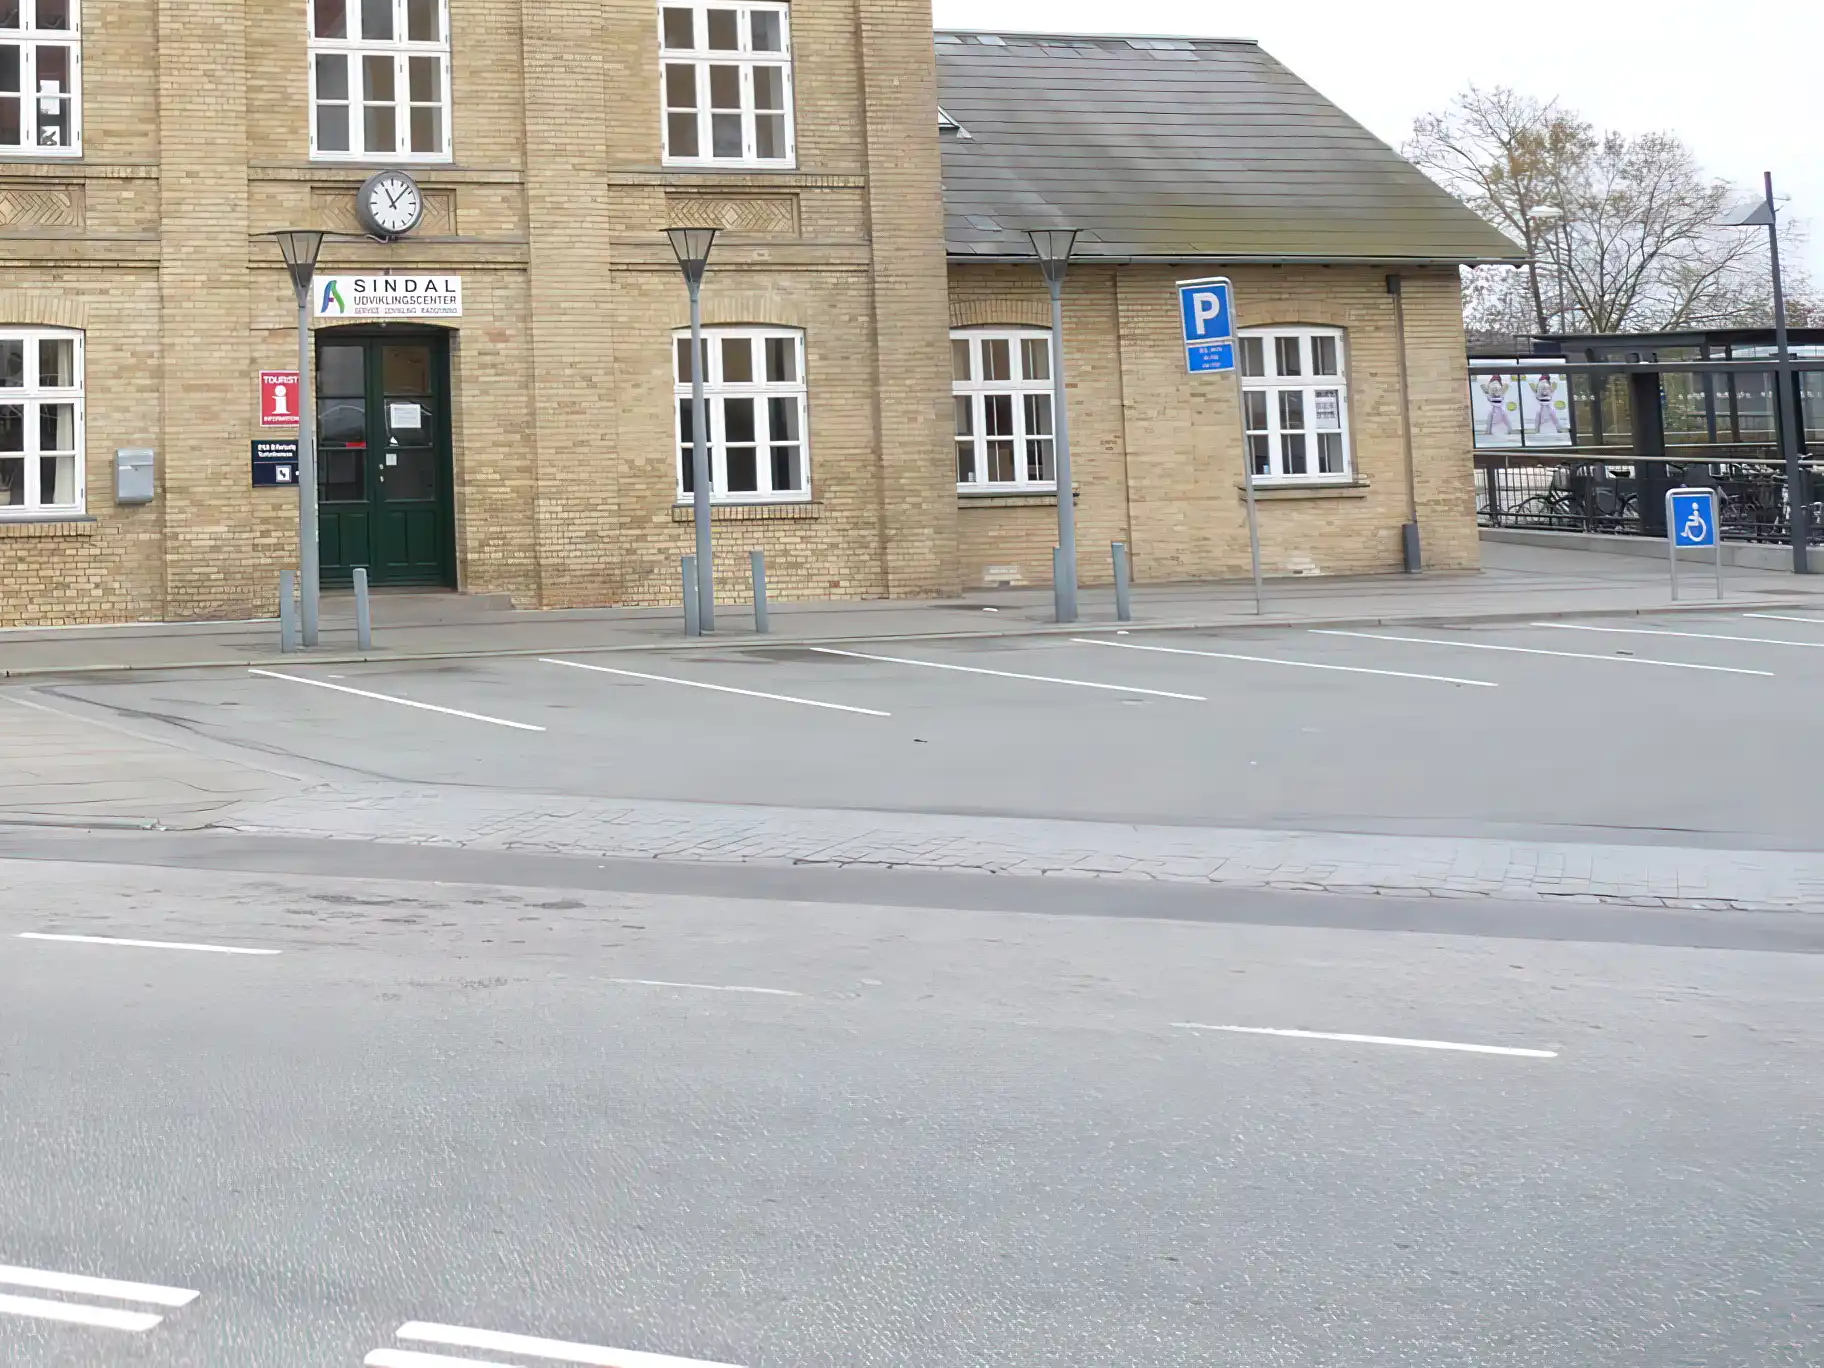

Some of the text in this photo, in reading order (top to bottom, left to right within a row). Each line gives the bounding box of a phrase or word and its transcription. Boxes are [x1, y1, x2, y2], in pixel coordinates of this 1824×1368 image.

[353, 279, 456, 293] SINDAL
[353, 295, 457, 305] UDVIKLINGSCENTER
[1192, 292, 1221, 335] P
[263, 375, 300, 384] TOURIST
